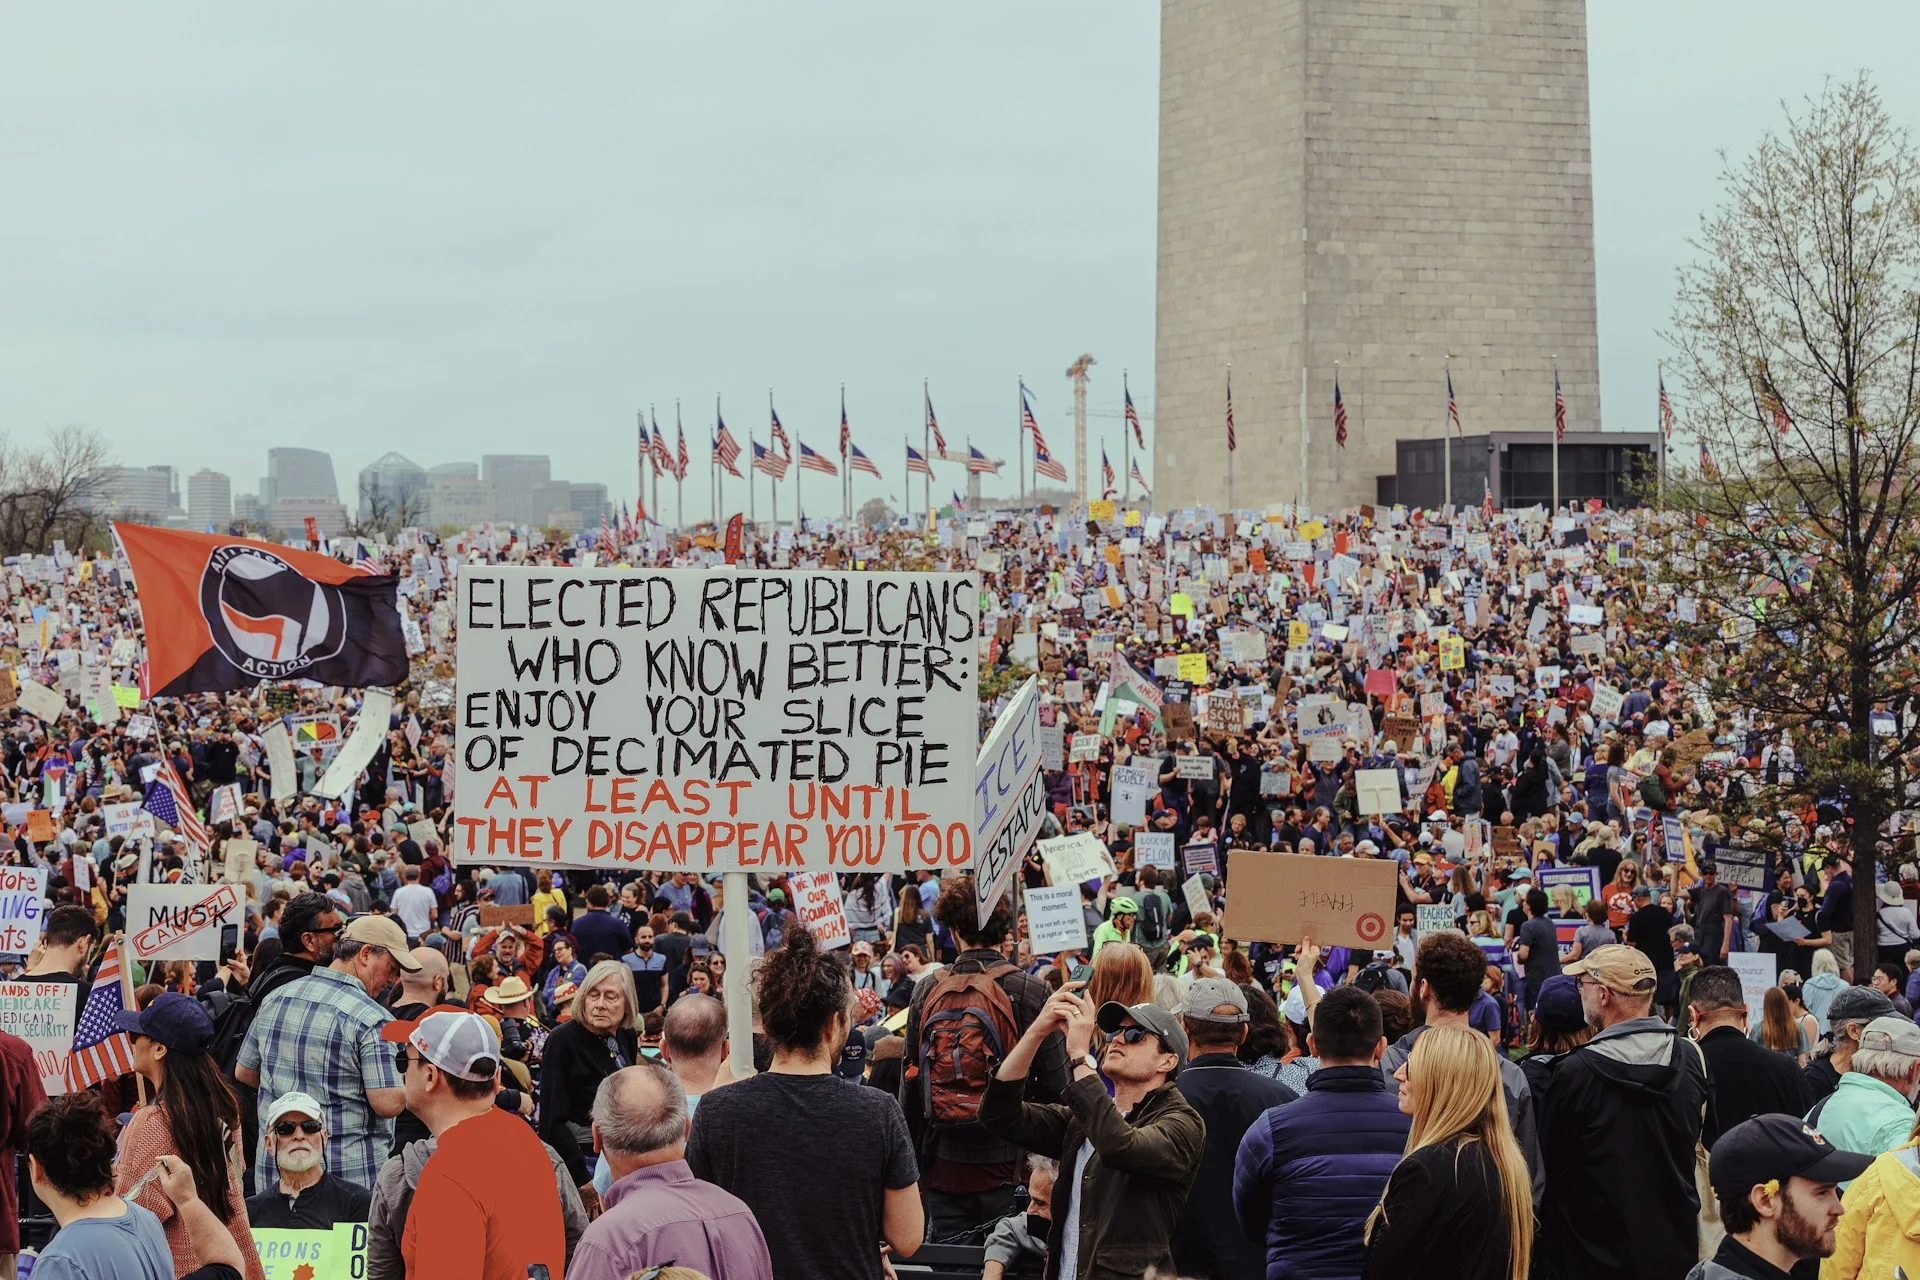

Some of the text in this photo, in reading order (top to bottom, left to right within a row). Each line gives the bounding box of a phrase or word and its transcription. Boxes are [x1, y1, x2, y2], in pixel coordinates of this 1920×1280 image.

[467, 576, 974, 644] ELECTED REPUBLICANS
[242, 654, 311, 676] ACTION
[507, 636, 969, 700] WHO KNOW BETTER:
[1209, 696, 1240, 710] MAGA
[465, 688, 925, 740] ENJOY YOUR SLICE
[1209, 709, 1240, 723] SCUM
[1227, 723, 1242, 733] OFF
[464, 736, 950, 788] OF DECIMATED PIE
[1114, 773, 1146, 786] TROUBLE
[483, 774, 932, 821] AT LEAST UNTIL
[455, 816, 971, 867] THEY DISAPPEAR YOU TOO
[1043, 840, 1085, 856] America
[1140, 835, 1172, 845] LOCK UP
[1137, 847, 1171, 864] FELON
[1065, 866, 1099, 882] Empire
[1723, 864, 1752, 875] FREE
[0, 868, 38, 893] tore
[792, 871, 834, 894] WE WANT
[1716, 873, 1755, 884] SPEECH
[807, 889, 829, 903] OUR
[1029, 892, 1043, 902] This
[1044, 891, 1050, 900] is
[1055, 889, 1073, 899] moral
[1299, 890, 1354, 913] FRAGILE
[2, 894, 40, 920] ING
[799, 897, 841, 923] COUNTRY
[1419, 906, 1453, 920] TEACHERS
[139, 895, 233, 951] CANCEL
[148, 904, 232, 928] MUSK
[1419, 921, 1455, 930] LET ME ASK
[0, 924, 27, 950] nts
[1046, 931, 1057, 940] right
[1735, 967, 1765, 975] NJUSTICE
[0, 984, 68, 997] ANDS OFF!
[0, 1023, 69, 1037] IAL SECURITY
[255, 1240, 322, 1261] ORONS
